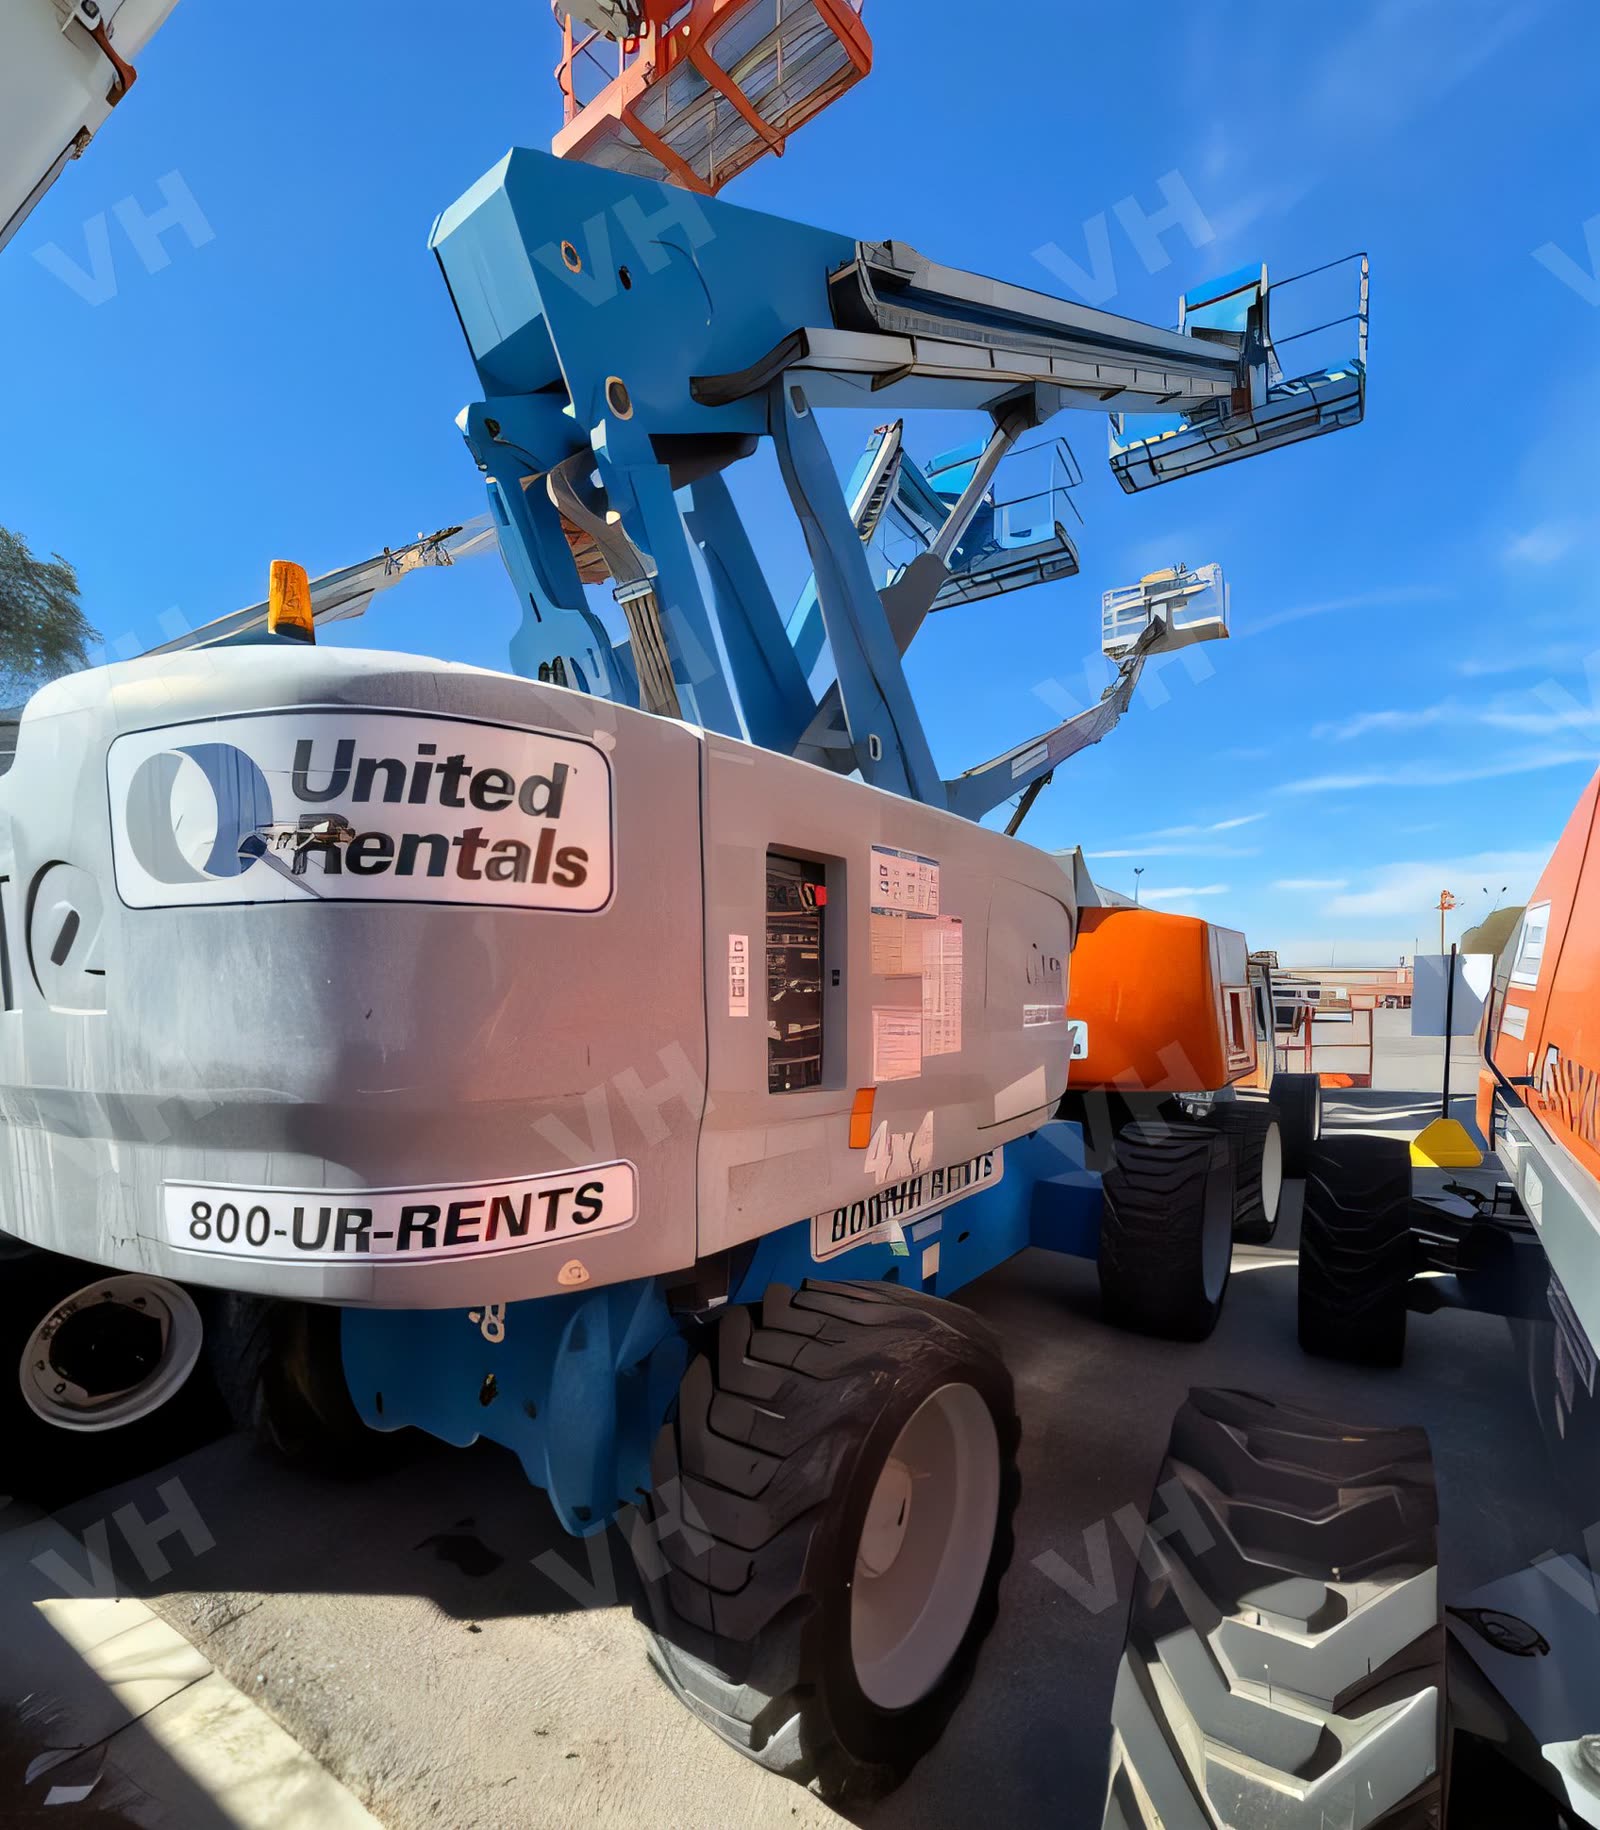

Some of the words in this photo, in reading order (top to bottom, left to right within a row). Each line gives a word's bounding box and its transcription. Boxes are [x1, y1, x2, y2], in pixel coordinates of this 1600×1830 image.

[291, 739, 572, 819] United
[290, 813, 589, 888] Rentals
[188, 1181, 604, 1253] 800-UR-RENTS
